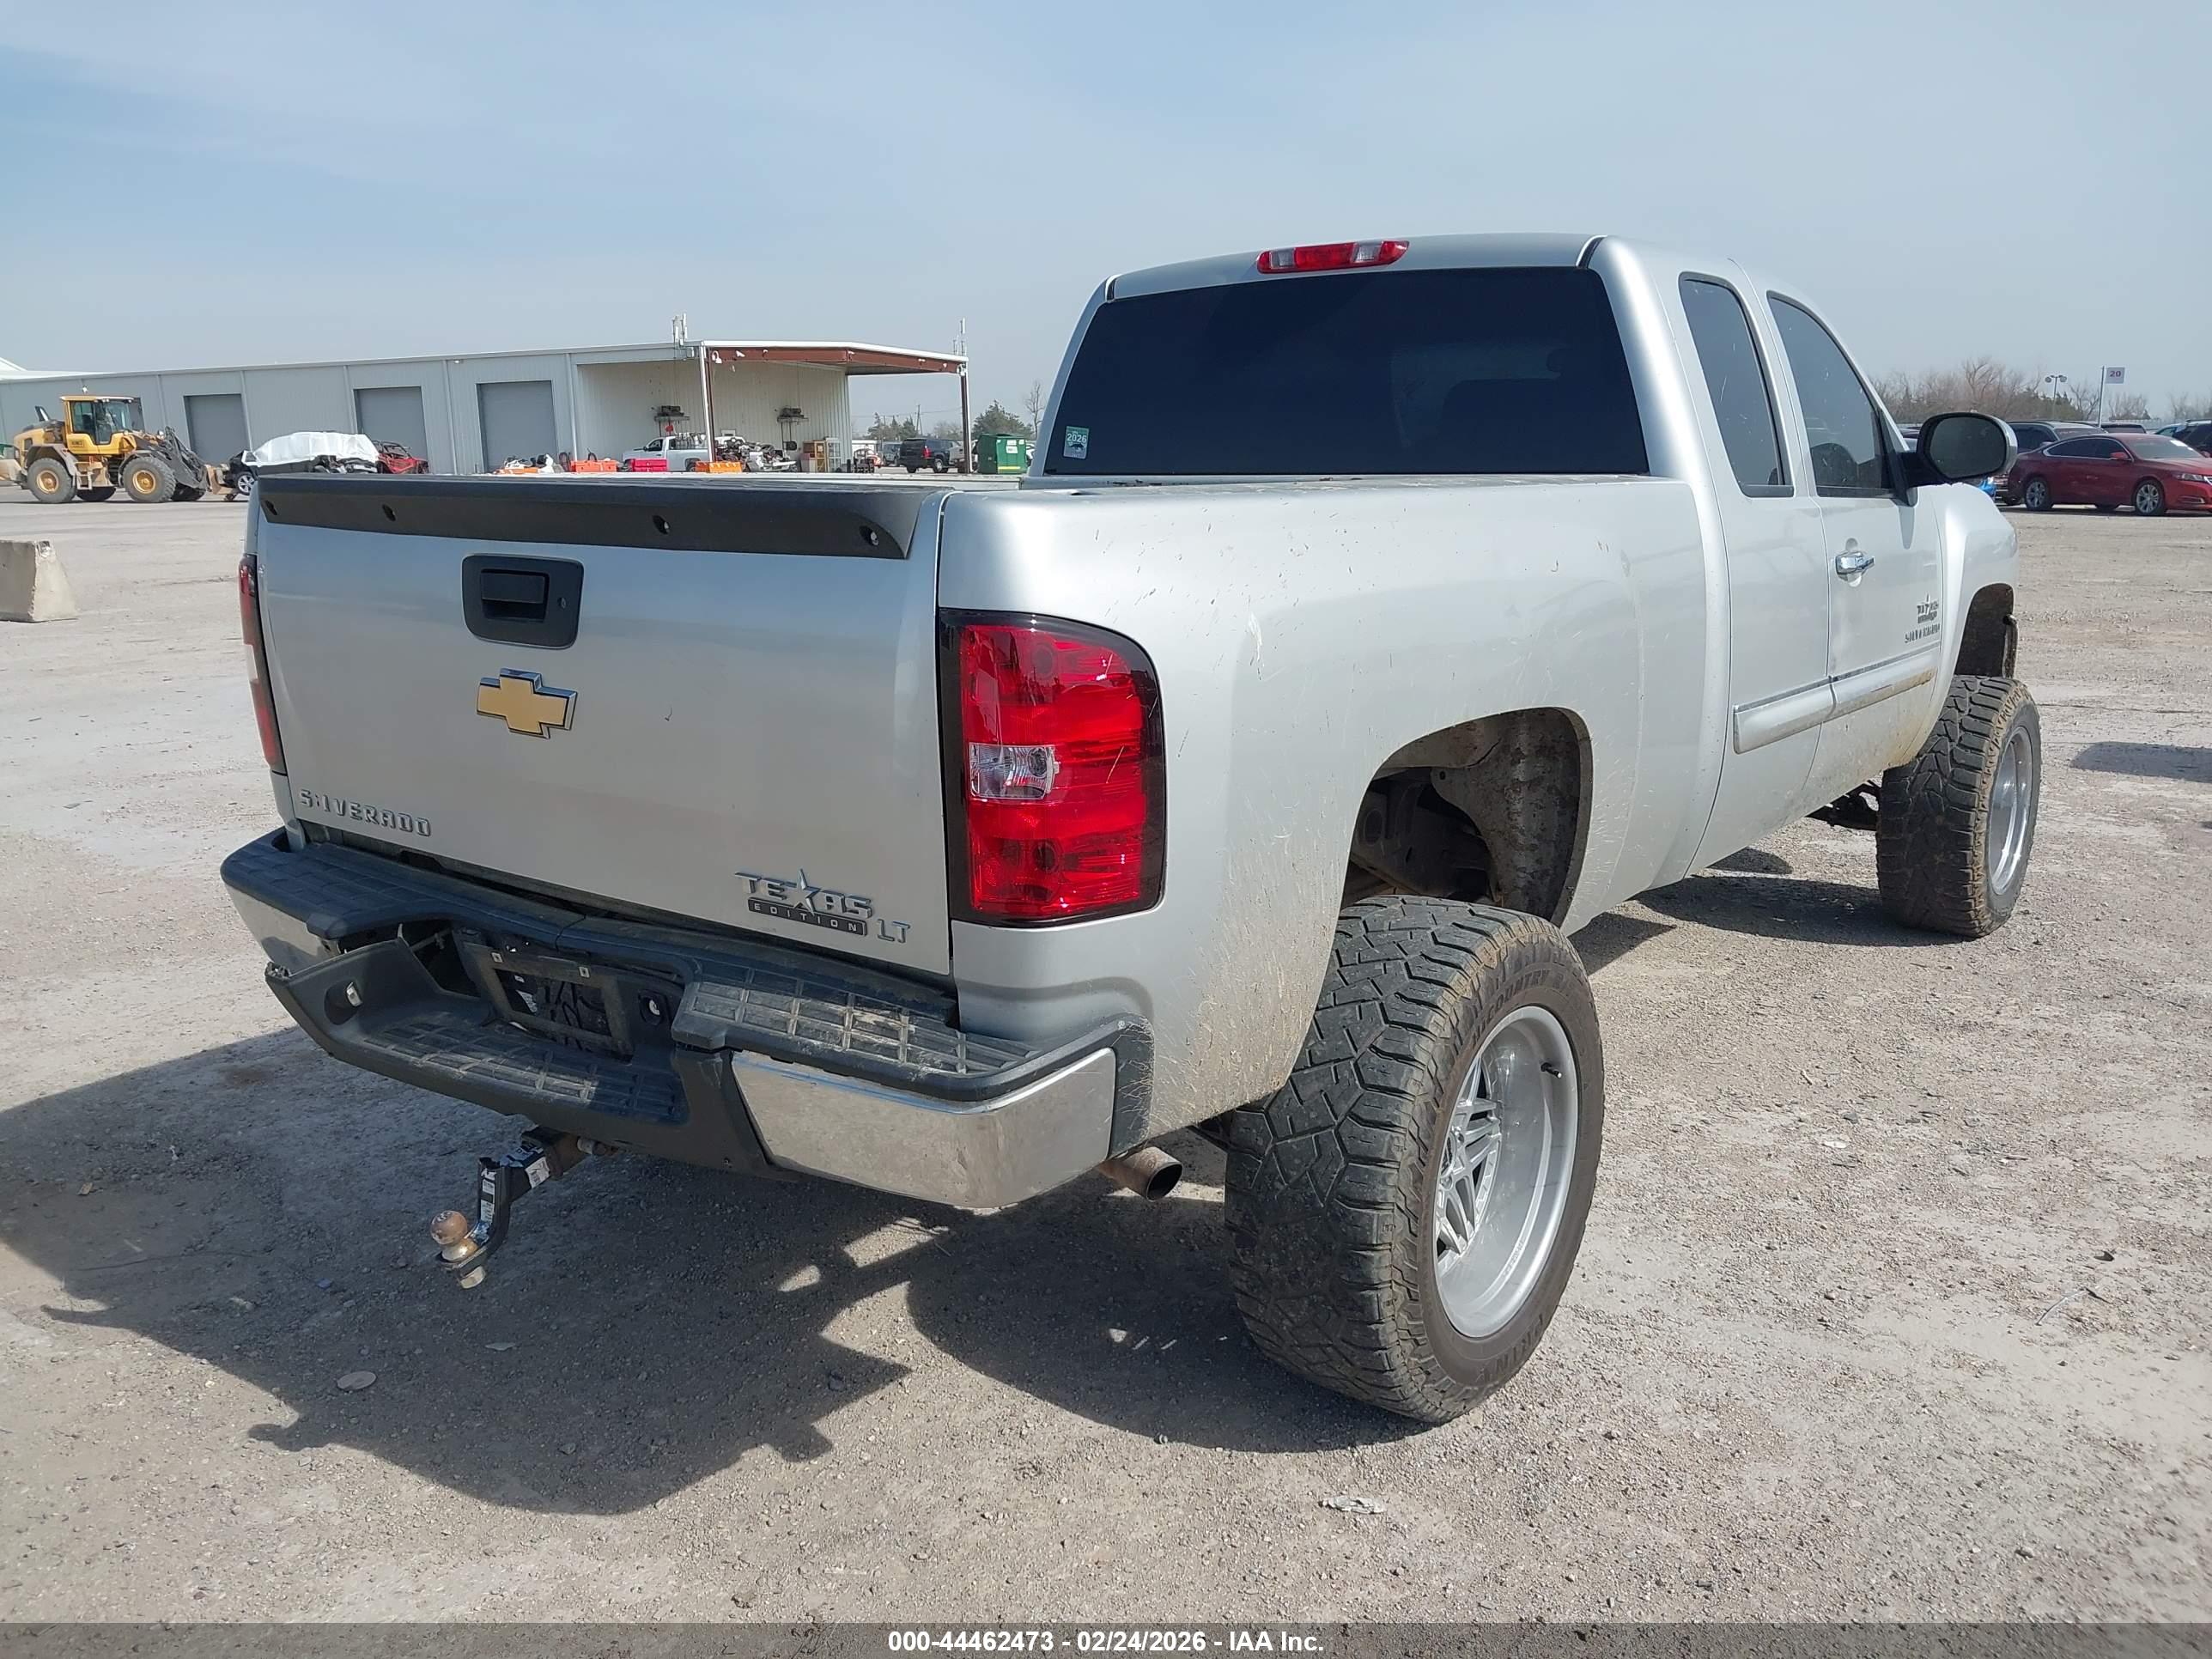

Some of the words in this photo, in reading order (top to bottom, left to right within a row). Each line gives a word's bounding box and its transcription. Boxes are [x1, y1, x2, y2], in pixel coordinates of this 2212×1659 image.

[1066, 433, 1087, 443] 2026
[734, 869, 873, 919] TEXAS
[754, 902, 858, 932] EDITION
[877, 919, 911, 943] LT
